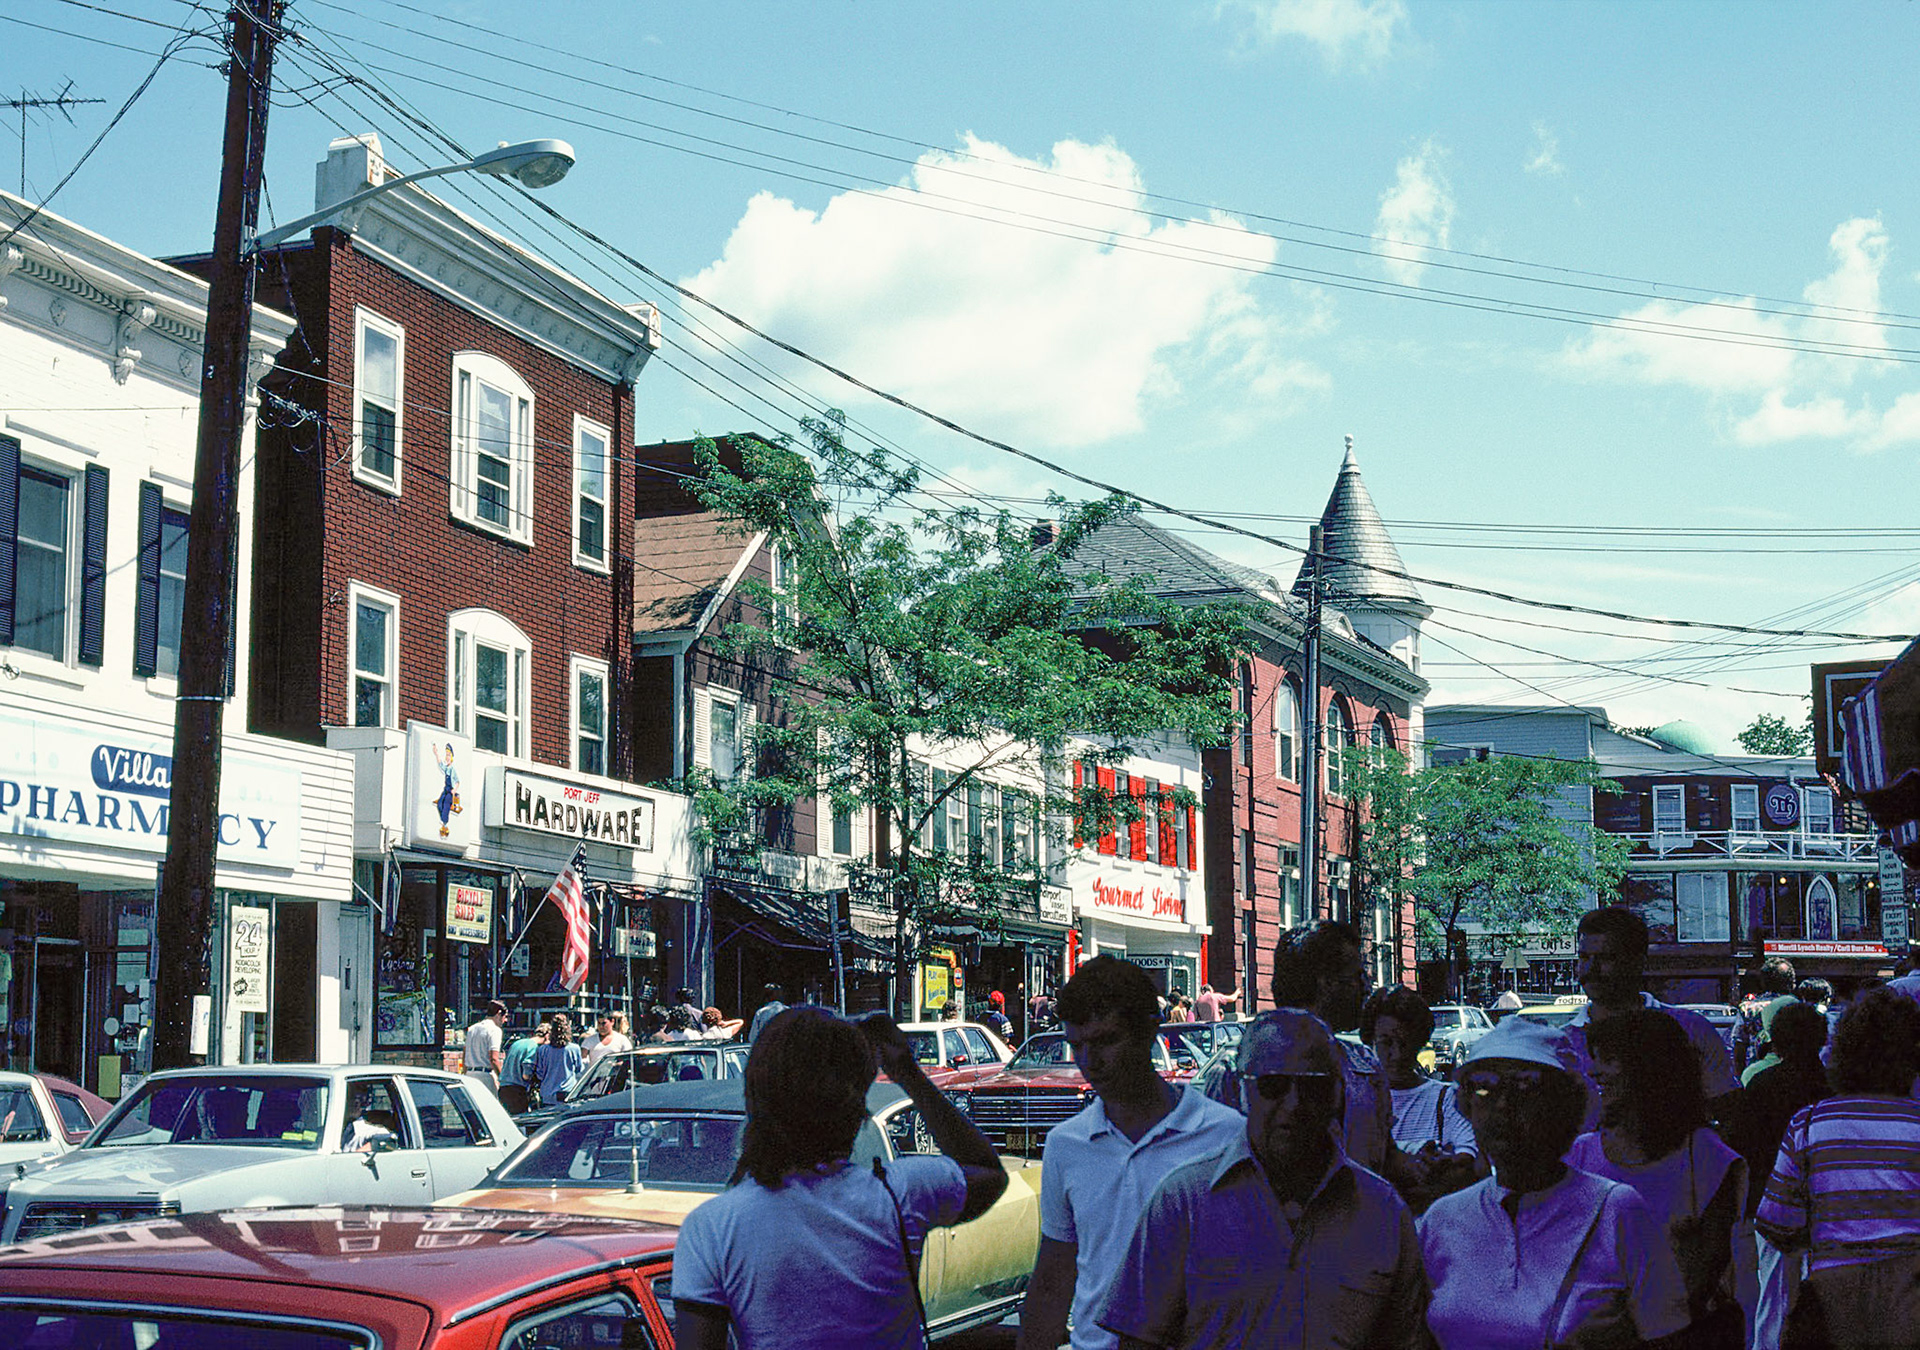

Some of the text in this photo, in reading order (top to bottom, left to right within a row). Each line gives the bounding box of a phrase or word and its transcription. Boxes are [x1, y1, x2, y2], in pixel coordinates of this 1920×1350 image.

[563, 786, 600, 804] PORT JEFF
[0, 779, 277, 850] PHARMCY
[515, 779, 642, 846] HARDWARE
[456, 887, 485, 907] BICYCLE
[1092, 876, 1185, 924] Gourmet Living
[455, 903, 476, 921] SALES
[235, 919, 262, 950] 24
[1797, 943, 1815, 953] Lynch
